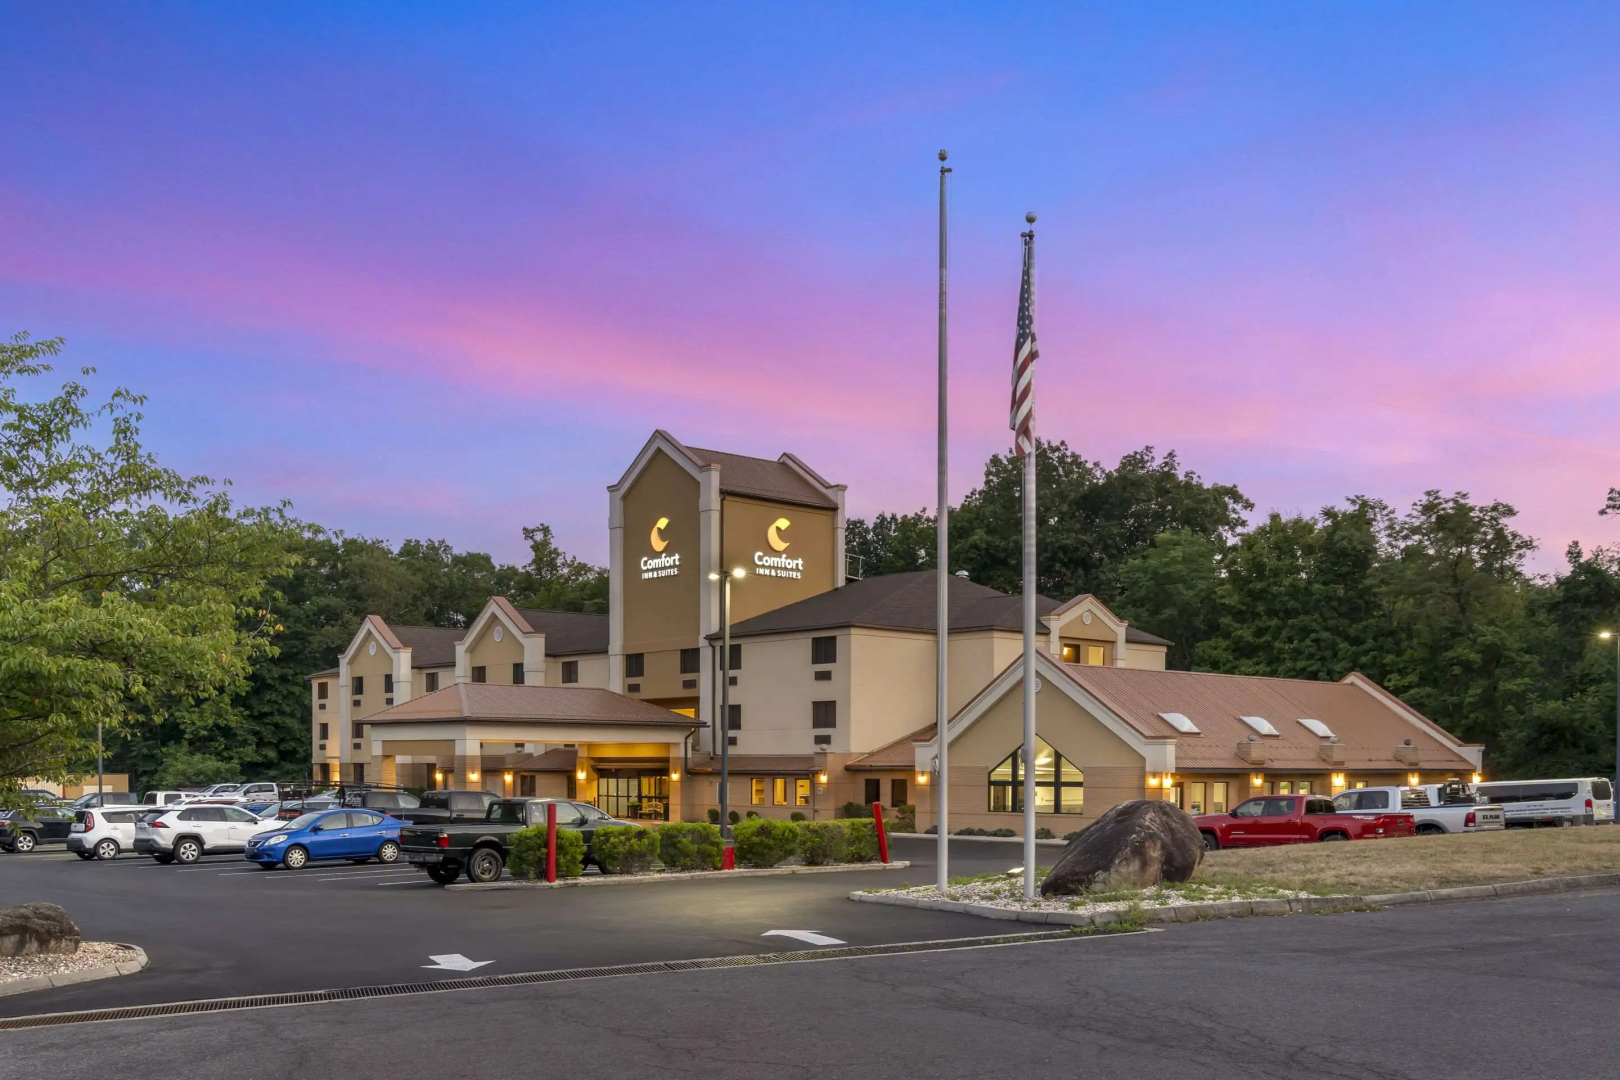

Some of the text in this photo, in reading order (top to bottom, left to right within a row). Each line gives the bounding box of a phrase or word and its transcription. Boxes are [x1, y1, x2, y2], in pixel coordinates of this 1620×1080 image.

[640, 553, 680, 570] Comfort
[754, 551, 804, 570] Comfort
[642, 571, 653, 580] INN
[658, 568, 678, 577] SUITES
[756, 568, 770, 576] INN
[777, 570, 802, 579] SUITES
